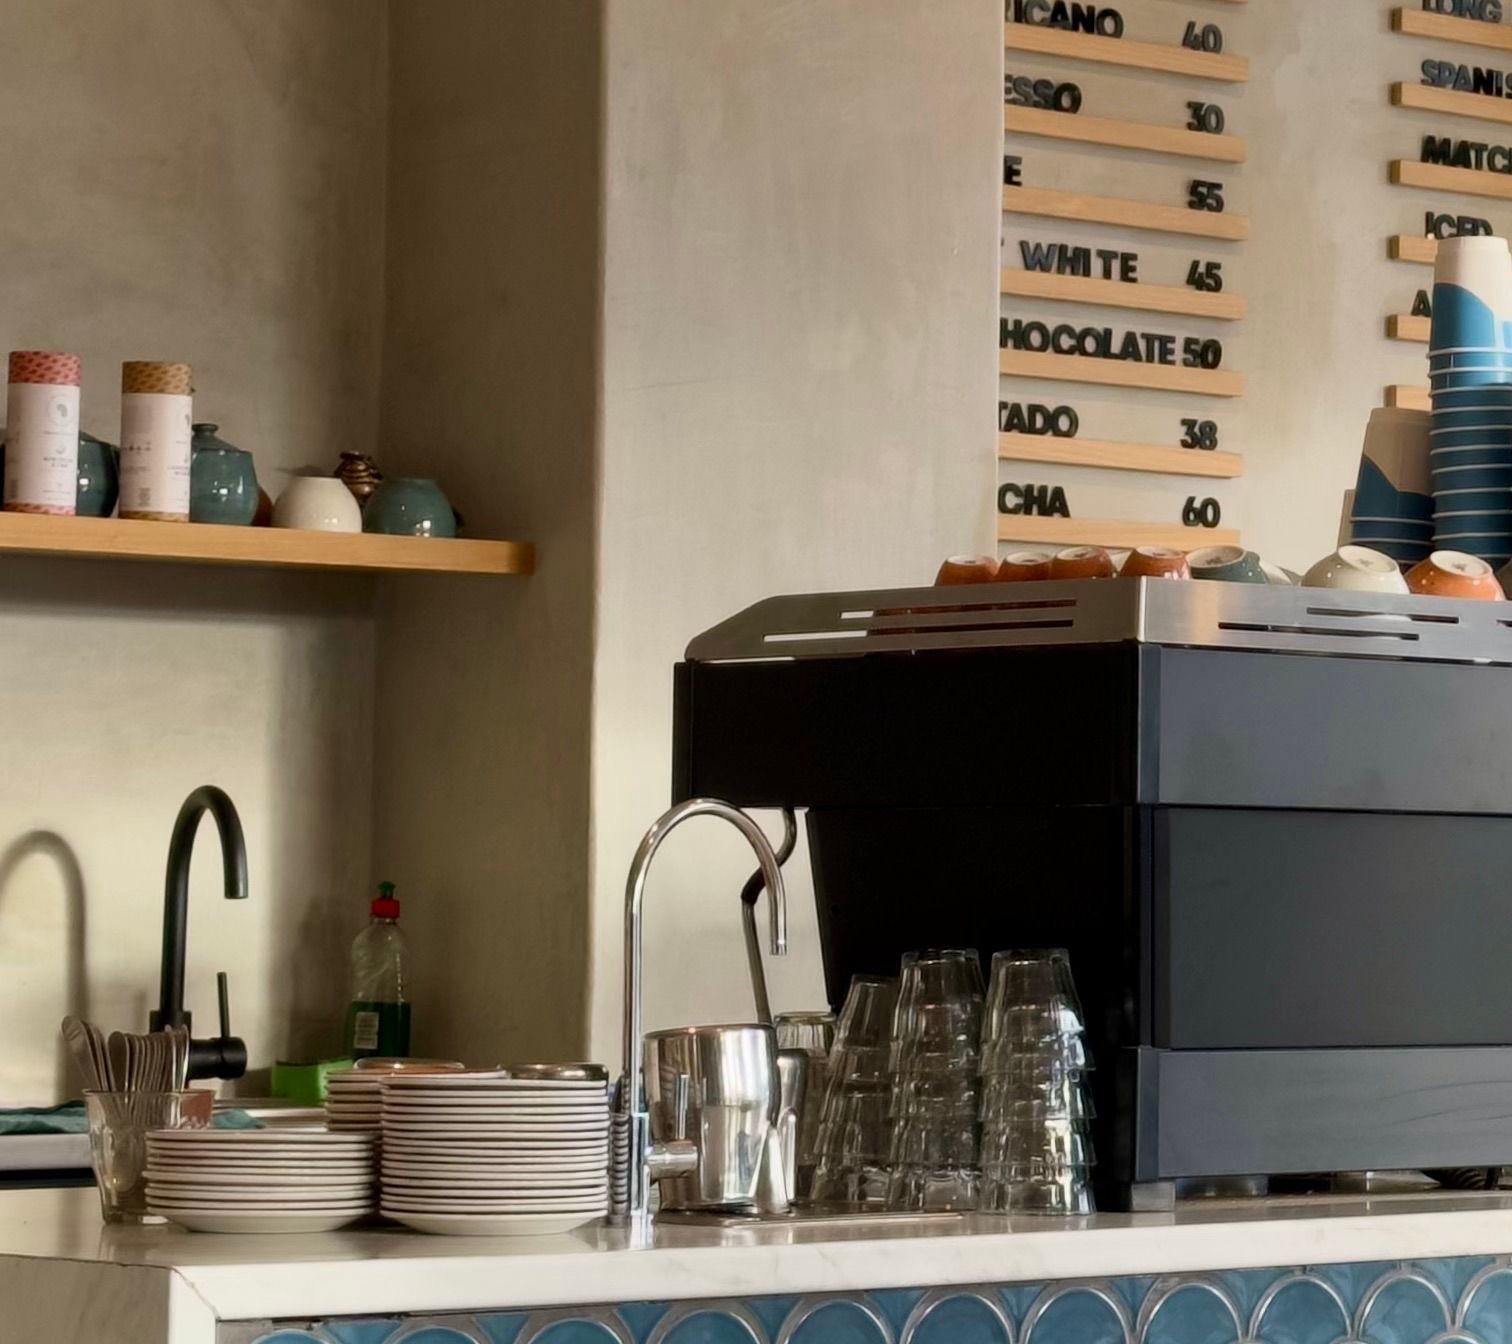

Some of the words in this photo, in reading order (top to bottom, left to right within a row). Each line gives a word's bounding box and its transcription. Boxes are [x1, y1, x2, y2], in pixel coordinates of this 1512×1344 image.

[1182, 21, 1223, 54] 40
[1186, 101, 1224, 134] 30
[1003, 155, 1022, 187] E
[1187, 179, 1224, 213] 55
[1019, 240, 1138, 283] WHITE
[1186, 260, 1223, 293] 45
[999, 317, 1176, 365] HOCOLATE
[1182, 337, 1223, 369] 50
[1180, 418, 1219, 451] 38
[998, 482, 1071, 518] CHA
[1182, 496, 1221, 528] 60
